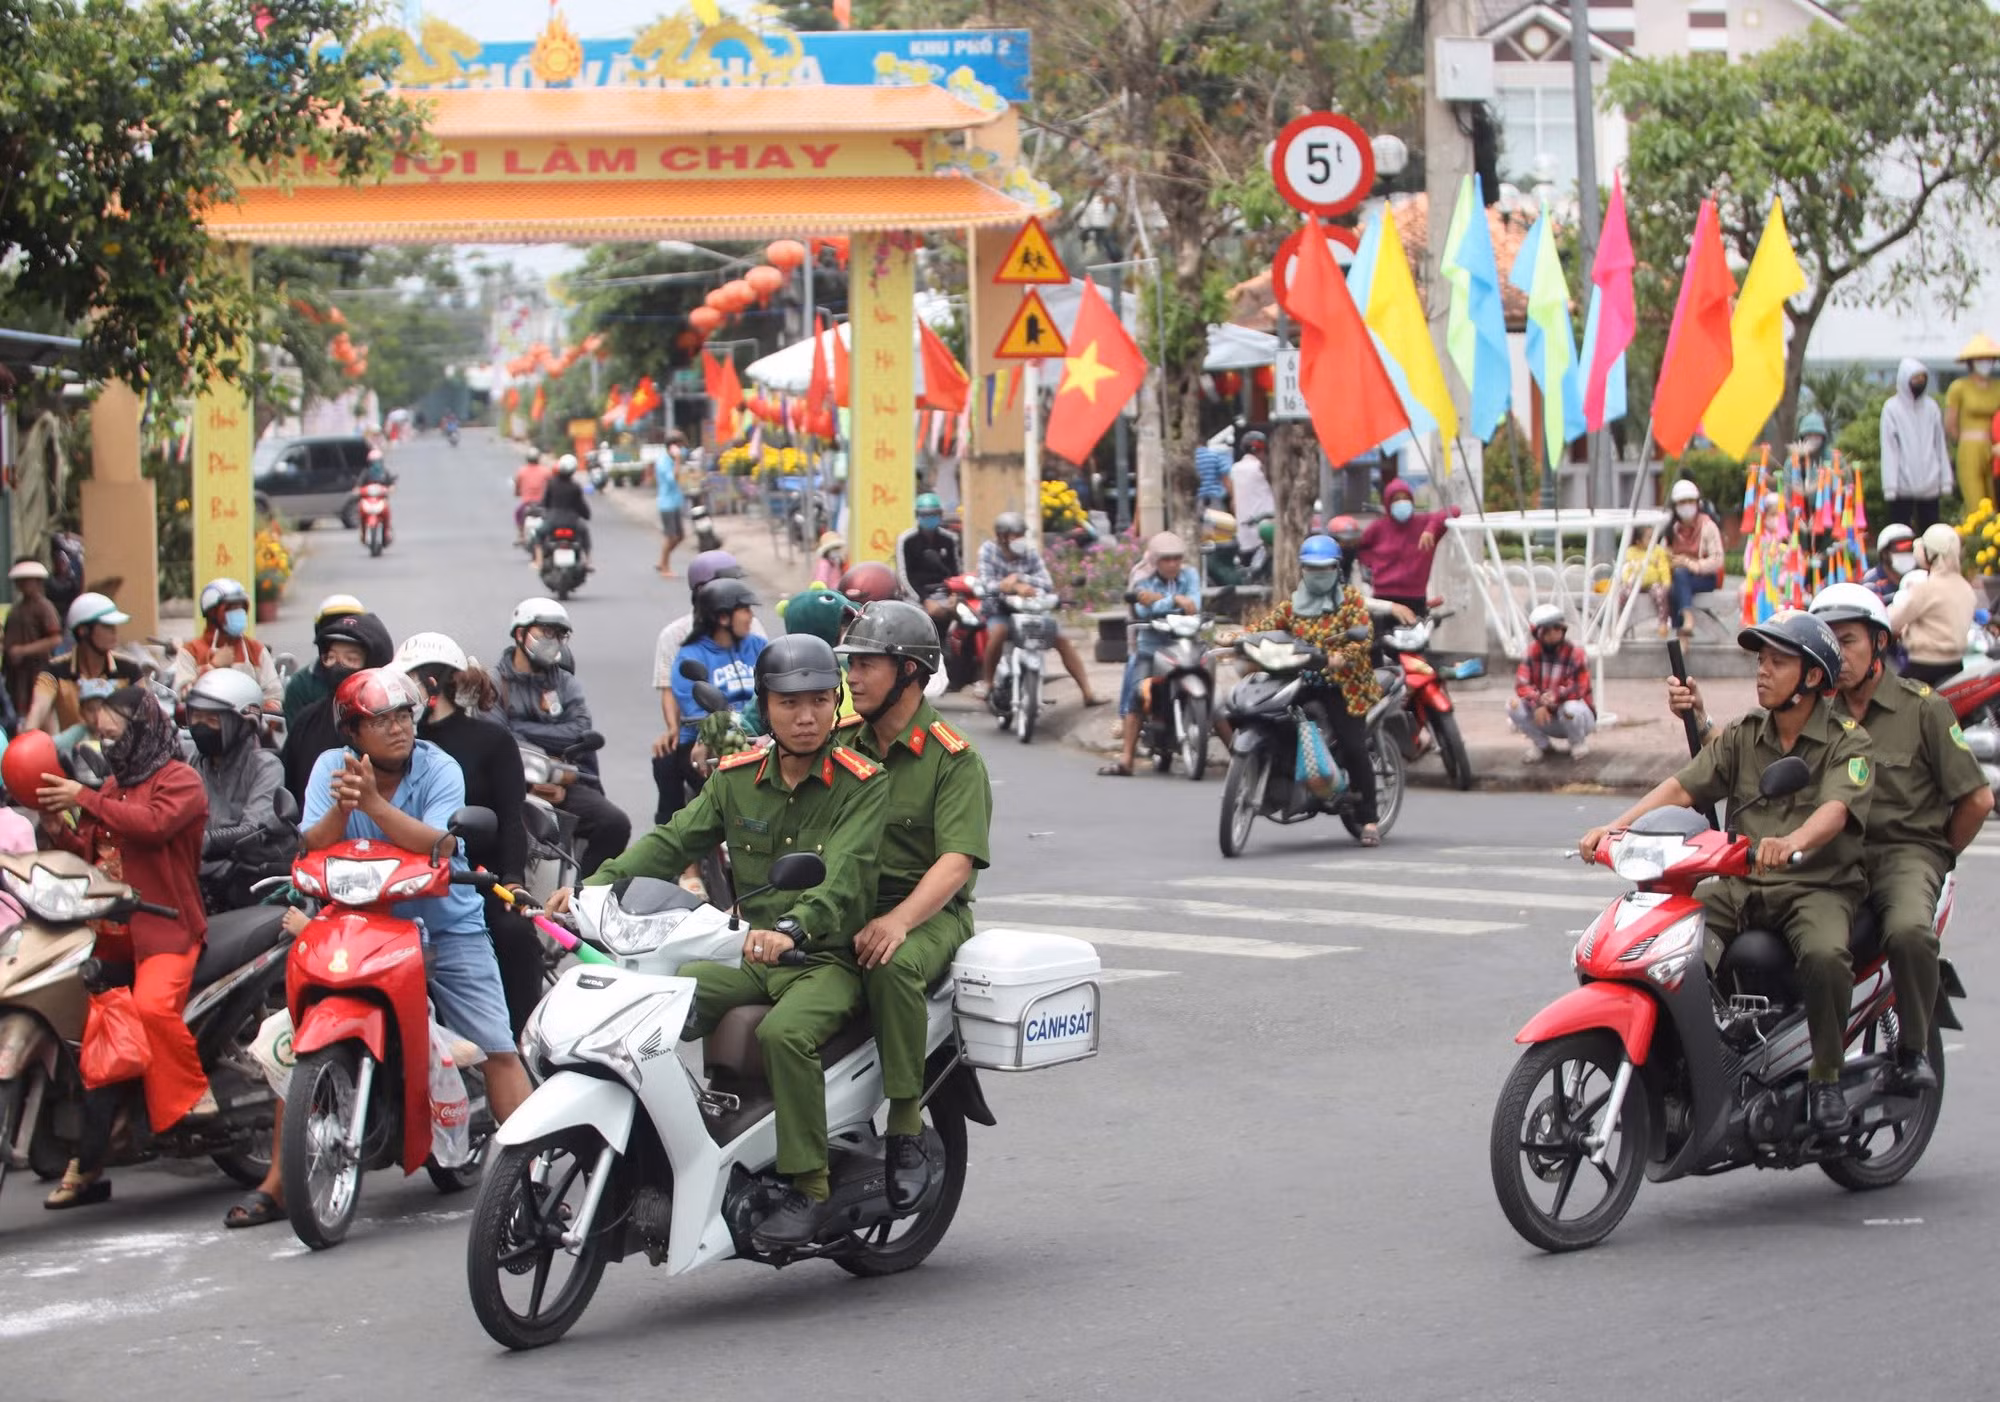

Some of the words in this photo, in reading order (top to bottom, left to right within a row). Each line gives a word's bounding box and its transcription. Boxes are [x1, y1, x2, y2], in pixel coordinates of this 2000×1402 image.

[909, 39, 949, 55] KHU
[504, 142, 637, 174] LÀM
[660, 143, 841, 171] CHAY
[1026, 1012, 1067, 1042] CẢNH
[1069, 1004, 1093, 1035] SÁT
[641, 1048, 671, 1062] HONDA
